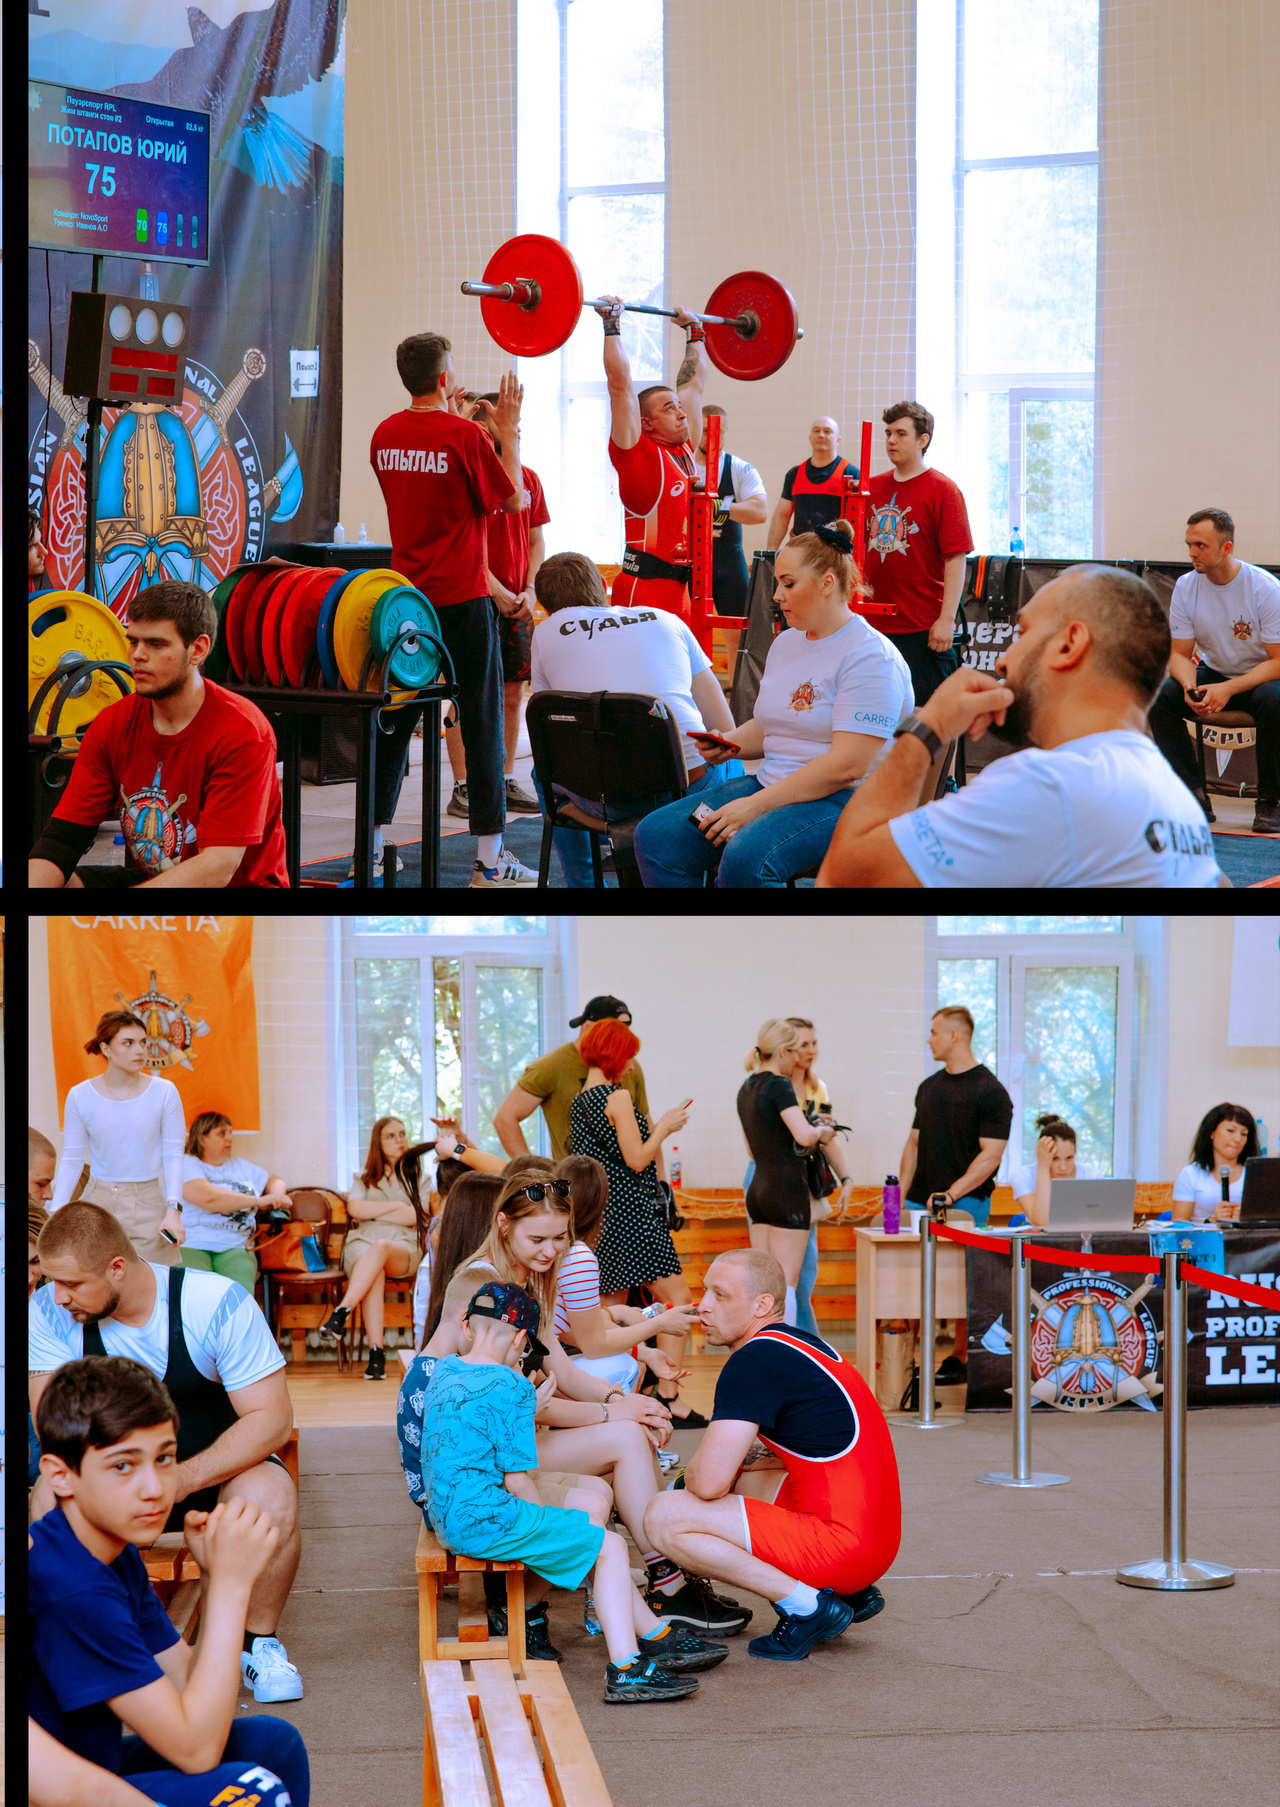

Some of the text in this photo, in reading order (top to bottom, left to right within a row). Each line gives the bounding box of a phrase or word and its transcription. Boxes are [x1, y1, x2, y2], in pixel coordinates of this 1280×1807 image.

[61, 105, 123, 123] Жим штанги стоя #2
[104, 102, 117, 112] RPL
[146, 115, 174, 127] Открытая
[48, 123, 187, 165] ПОТАПОВ ЮРИЙ
[85, 162, 116, 197] 75
[53, 208, 108, 223] Команда: NovoSport
[136, 219, 148, 232] 70
[157, 222, 168, 234] 75
[377, 448, 449, 474] КУЛЬТЛАБ
[234, 436, 262, 561] LEAGUE
[1203, 727, 1252, 745] RPL
[1042, 1278, 1156, 1369] PROFESSIONAL LEAGUE
[1205, 1344, 1280, 1386] LE
[1059, 1395, 1113, 1409] RPL
[652, 1602, 663, 1610] CAT
